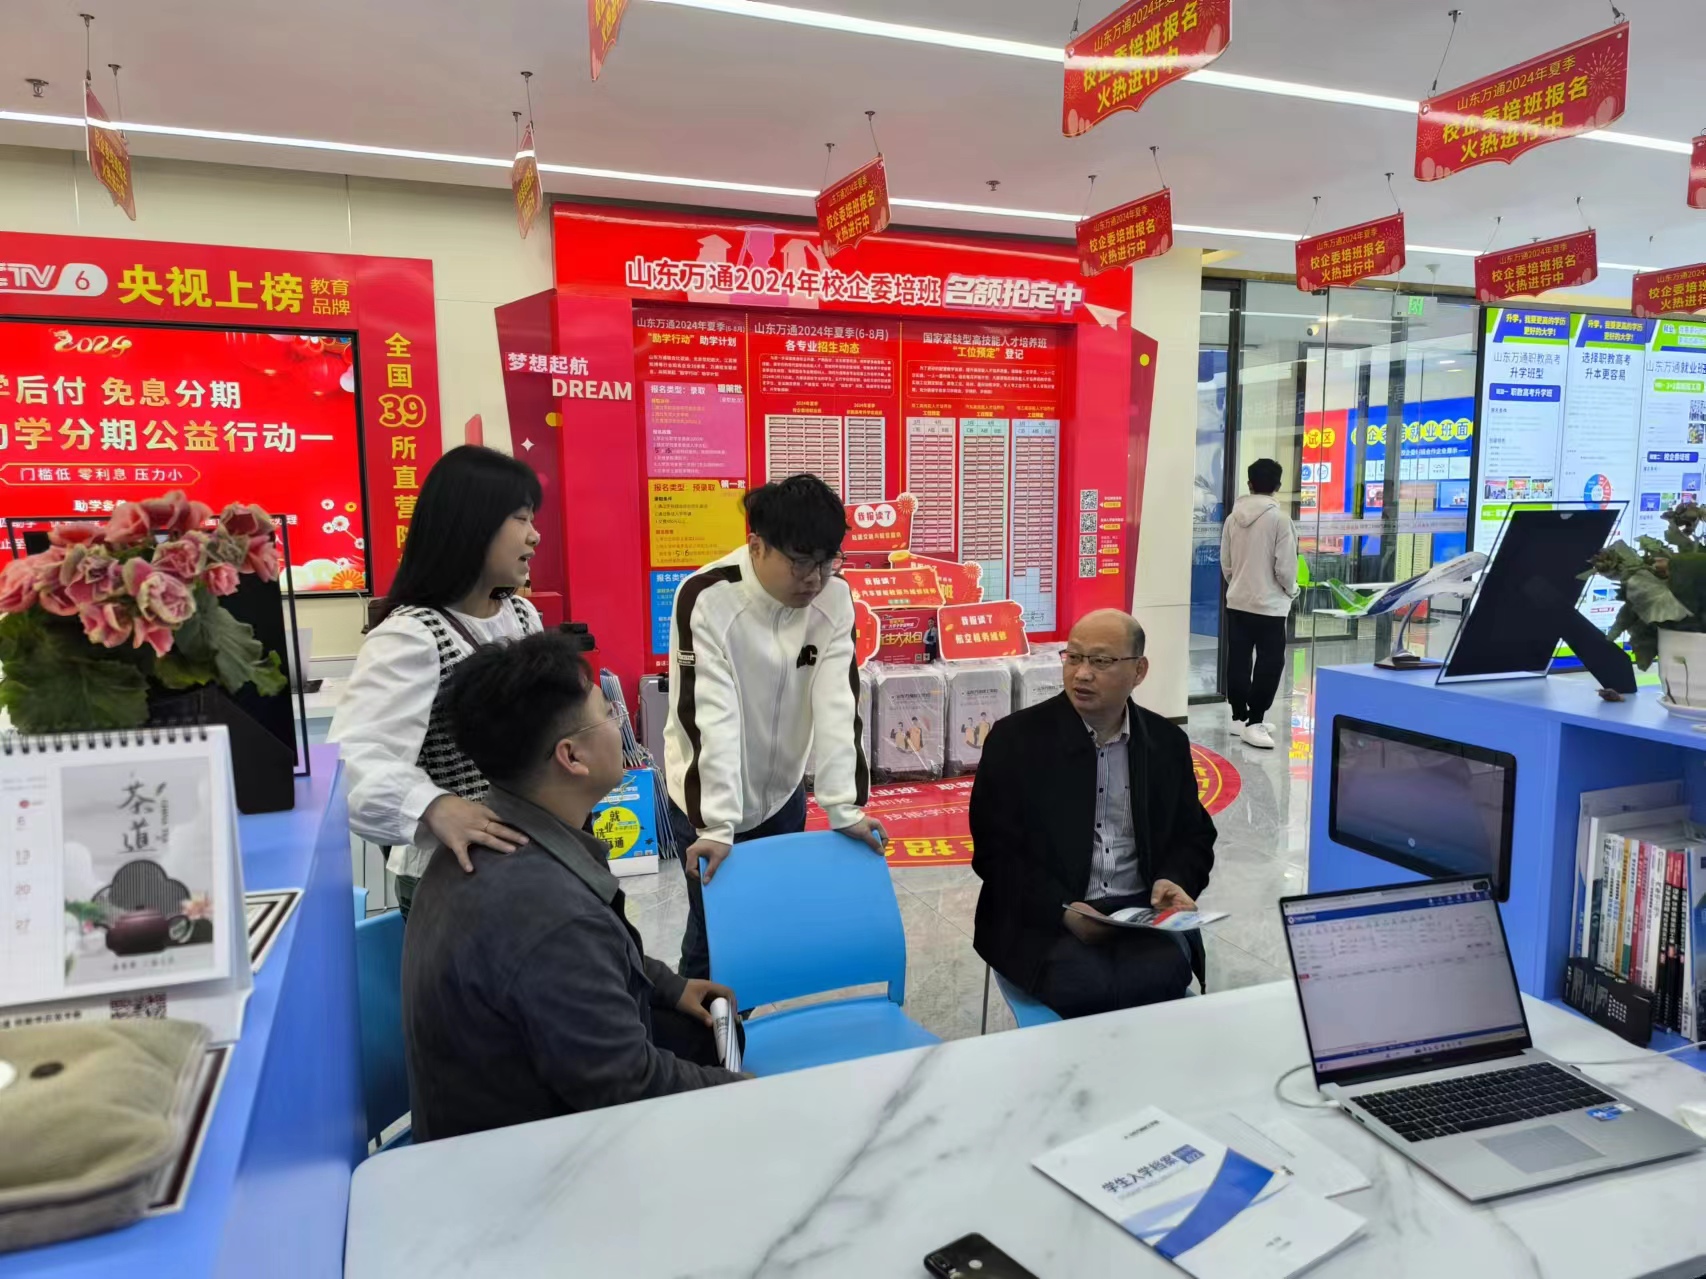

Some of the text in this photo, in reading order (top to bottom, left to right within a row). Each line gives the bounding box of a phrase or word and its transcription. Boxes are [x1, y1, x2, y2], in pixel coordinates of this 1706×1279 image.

[1097, 46, 1180, 113] 火热进行中
[1457, 55, 1577, 111] 山东万通2024年夏季
[1442, 75, 1588, 144] 校企委培班报名
[1460, 111, 1564, 162] 火热进行中
[1089, 218, 1156, 253] 校企委培班报名
[1316, 227, 1378, 251] 山东万通2024年夏季
[1100, 239, 1146, 267] 火热进行中
[1310, 240, 1386, 270] 校企委培班报名
[1321, 259, 1375, 283] 火热进行中
[1491, 254, 1577, 282] 校企委培班报名
[117, 264, 304, 313] 央视上榜
[311, 277, 349, 296] 教育
[625, 255, 1083, 312] 山东万通2024年校企委培班 名额抢定中
[1504, 272, 1564, 294] 火热进行中
[312, 298, 351, 316] 品牌
[699, 335, 737, 347] 助学计划
[754, 322, 889, 341] 山东万通2024年夏季(6-8月)
[923, 332, 1048, 349] 国家紧缺型高技能人才培养班
[53, 329, 132, 358] 2024
[785, 340, 860, 354] 各专业招生动态
[1004, 349, 1024, 360] 登记
[508, 352, 589, 376] 梦想起航
[1493, 352, 1561, 365] 山东万通职教高考
[1582, 352, 1632, 366] 选择职教高考
[1509, 367, 1544, 379] 升学班型
[1585, 368, 1626, 381] 升本更容易
[101, 376, 241, 409] 免息分期
[552, 378, 632, 401] DREAM
[20, 467, 183, 481] 门槛低 零利息 压力小
[857, 511, 892, 521] 我报读了
[864, 577, 897, 586] 我报读了
[961, 615, 993, 626] 我报读了
[118, 781, 156, 854] 茶道
[1101, 1154, 1179, 1194] 学生入学档案
